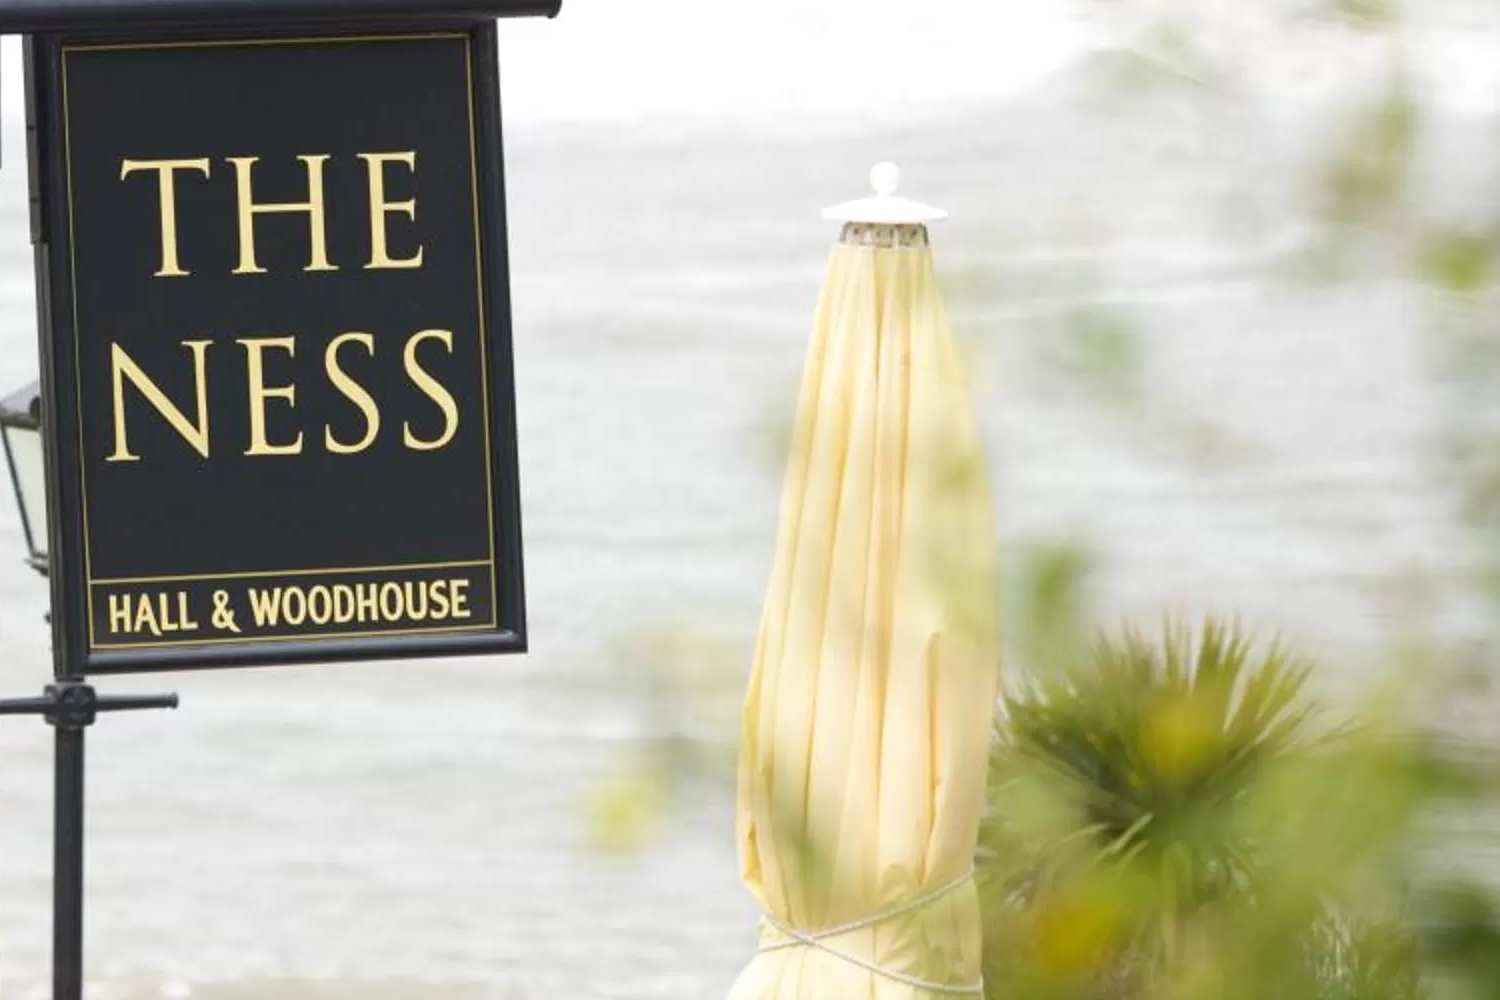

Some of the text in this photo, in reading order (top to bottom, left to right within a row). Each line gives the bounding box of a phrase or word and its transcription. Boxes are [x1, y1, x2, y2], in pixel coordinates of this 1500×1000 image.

[119, 150, 424, 278] THE
[104, 329, 460, 463] NESS
[108, 579, 471, 637] HALL & WOODHOUSE
